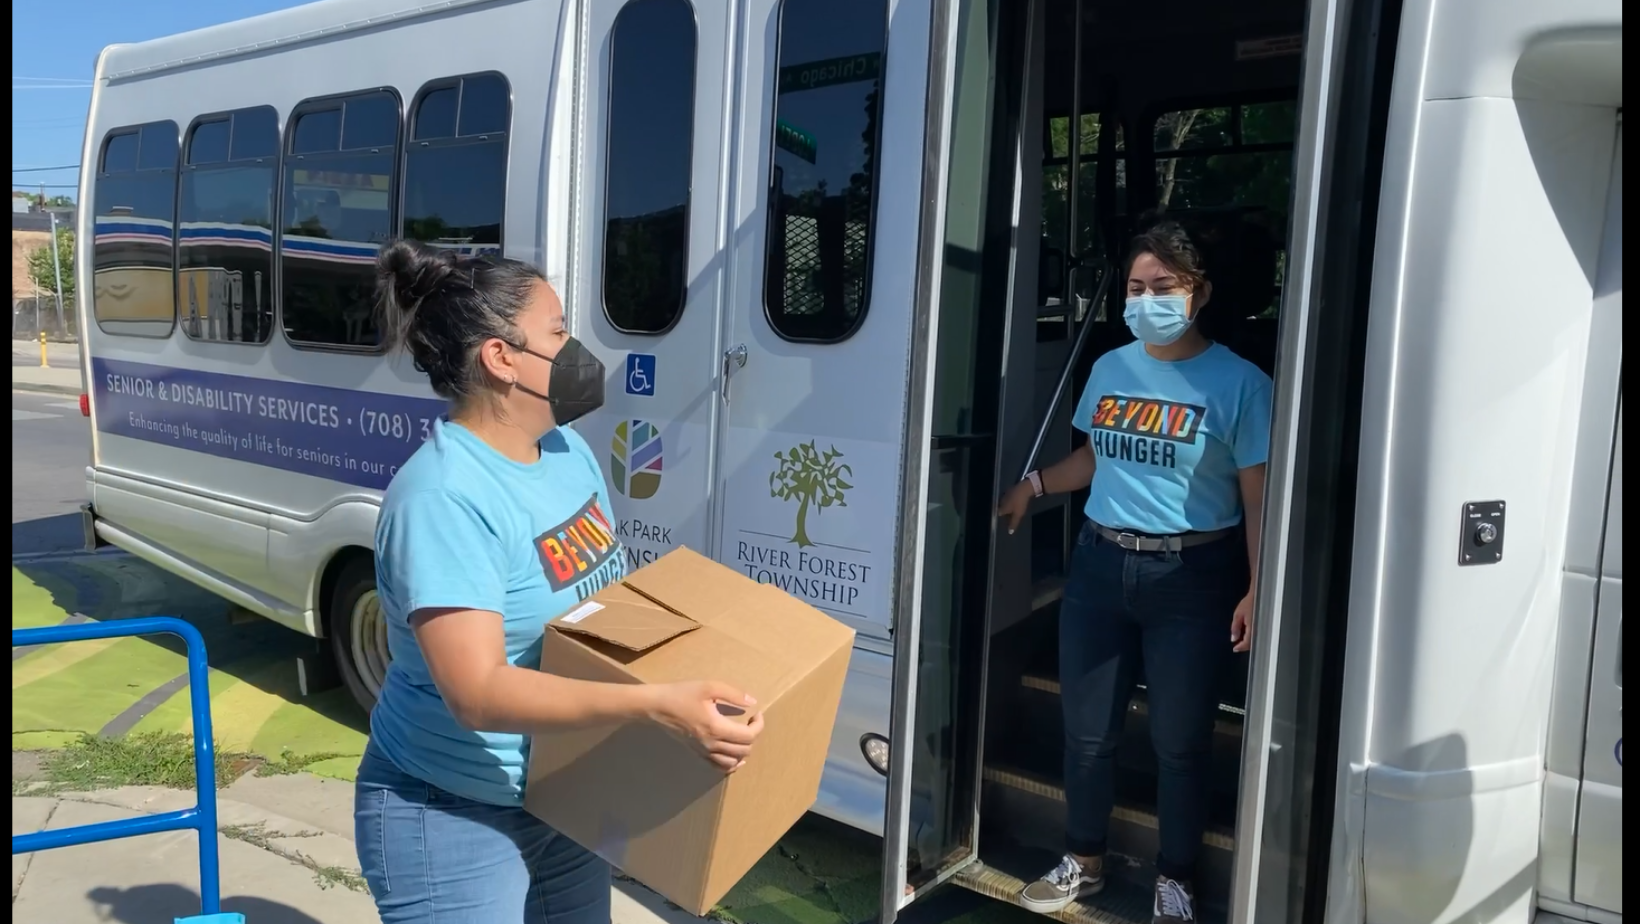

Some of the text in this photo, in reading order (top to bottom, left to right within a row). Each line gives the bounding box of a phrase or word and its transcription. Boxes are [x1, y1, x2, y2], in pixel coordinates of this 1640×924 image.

[106, 373, 154, 399] SENIOR
[158, 380, 168, 401] &
[171, 383, 253, 414] DISABILITY
[258, 395, 339, 428] SERVICES
[359, 407, 411, 442] (708)
[1093, 399, 1196, 438] BEYOND
[129, 411, 179, 439] Enhancing
[182, 422, 198, 439] the
[201, 428, 238, 451] quality
[241, 432, 252, 449] of
[255, 434, 273, 454] life
[276, 438, 293, 457] for
[296, 447, 341, 467] seniors
[344, 452, 357, 470] in
[361, 460, 385, 475] our
[1093, 430, 1176, 468] HUNGER
[541, 502, 616, 582] BEYON
[632, 519, 672, 545] PARK
[737, 540, 871, 583] RIVER FOREST
[744, 563, 859, 605] TOWNSHIP
